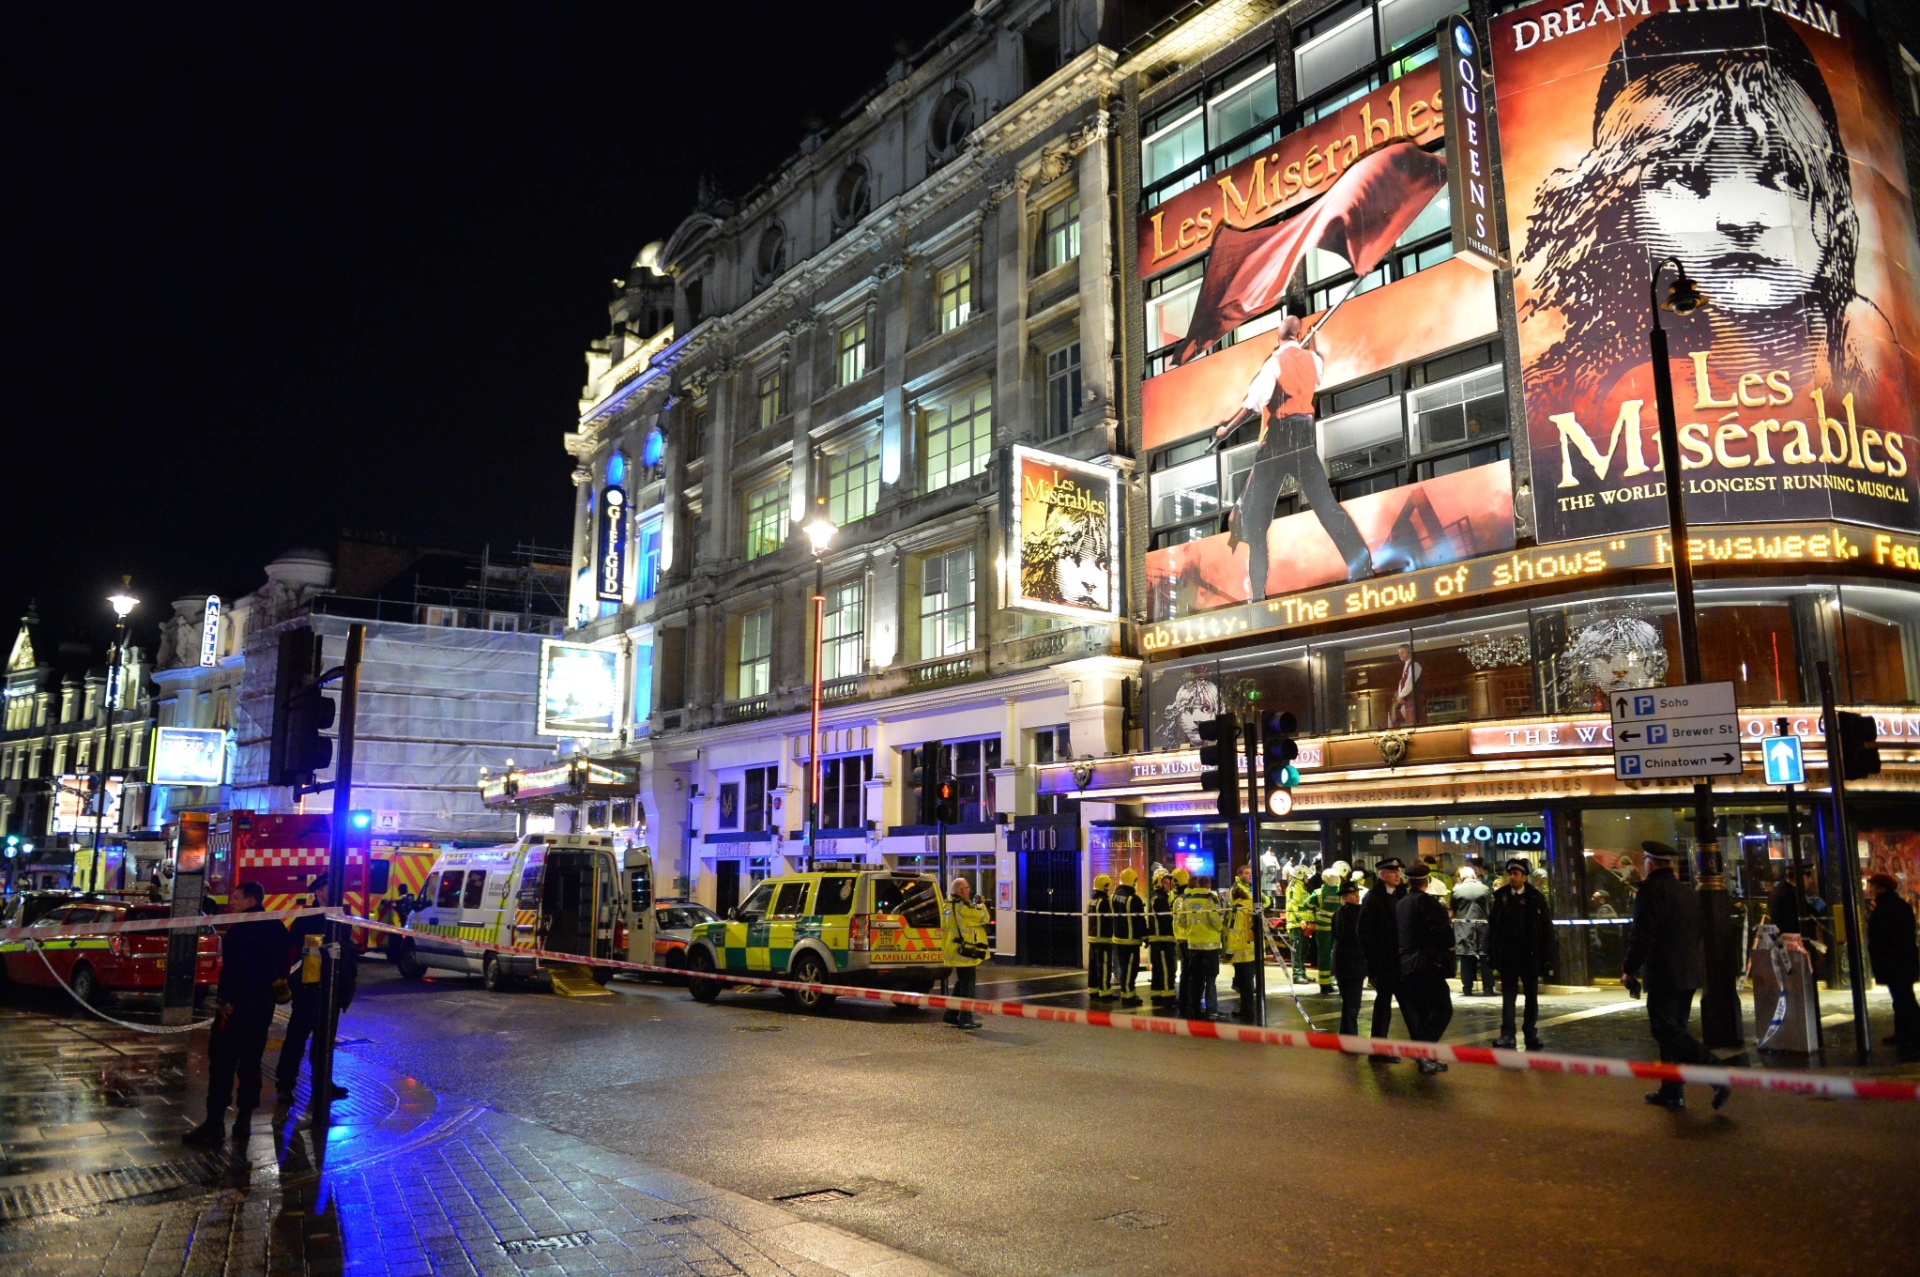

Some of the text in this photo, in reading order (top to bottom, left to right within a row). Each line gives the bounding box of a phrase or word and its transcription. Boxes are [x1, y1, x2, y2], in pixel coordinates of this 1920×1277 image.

[1513, 0, 1652, 51] DREAM
[1458, 57, 1486, 238] QUEENS
[1151, 206, 1213, 264] Les
[1467, 236, 1498, 259] THEATRE
[1688, 350, 1794, 411] Les
[1053, 470, 1075, 492] Les
[1557, 474, 1909, 513] THE WORLD LONGEST RUNNING MUSICAL
[1024, 475, 1106, 515] Misérables
[605, 505, 621, 593] GIELGUD
[1143, 614, 1248, 650] ability.
[1268, 599, 1330, 624] "The
[1346, 580, 1417, 612] show
[1434, 564, 1468, 596] of
[1874, 533, 1920, 570] Fea
[1660, 698, 1689, 708] Soho
[1504, 726, 1560, 747] THE
[1672, 727, 1714, 738] Brewer
[1719, 724, 1733, 735] St
[1133, 764, 1157, 777] THE
[1645, 757, 1707, 769] Chinatown
[1330, 792, 1352, 804] AND
[1441, 783, 1467, 798] LES
[1475, 779, 1583, 797] MISERABLES
[1021, 825, 1057, 851] club
[873, 953, 944, 961] AMBULANCE
